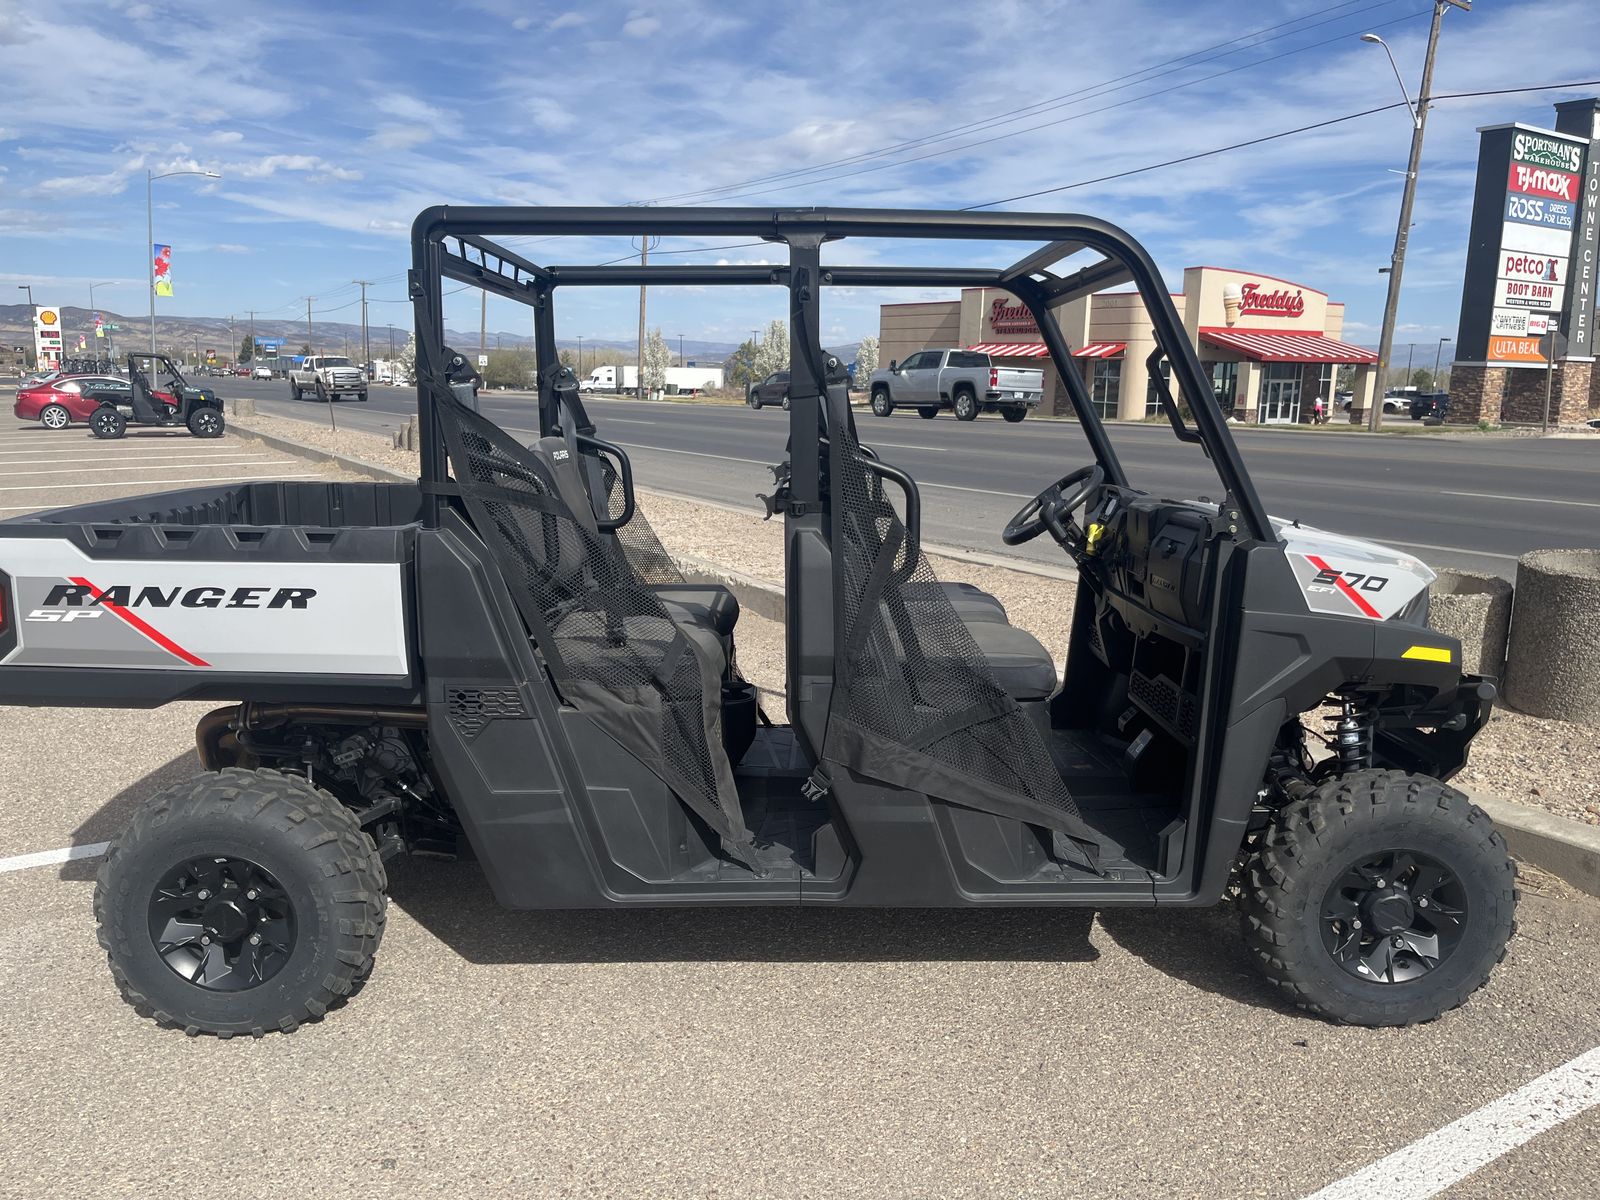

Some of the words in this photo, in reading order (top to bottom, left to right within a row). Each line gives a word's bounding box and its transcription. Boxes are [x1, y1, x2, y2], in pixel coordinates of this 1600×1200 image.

[1513, 134, 1581, 172] SPORTSMAN'S
[1524, 154, 1570, 170] WAREHOUSE
[1509, 197, 1544, 222] ROSS
[1550, 203, 1568, 214] DRESS
[1586, 162, 1599, 241] TOWNE
[1544, 213, 1555, 224] FOR
[1506, 255, 1544, 276] petco
[1238, 283, 1304, 316] Freddy's
[1507, 283, 1530, 296] BOOT
[1531, 286, 1553, 298] BARN
[1577, 250, 1592, 343] CENTER
[1499, 315, 1526, 324] ANYTIME
[1499, 323, 1526, 331] FITNESS
[1496, 341, 1517, 355] ULTA
[1312, 568, 1389, 592] 570
[42, 584, 318, 610] RANGER
[25, 609, 104, 623] SP
